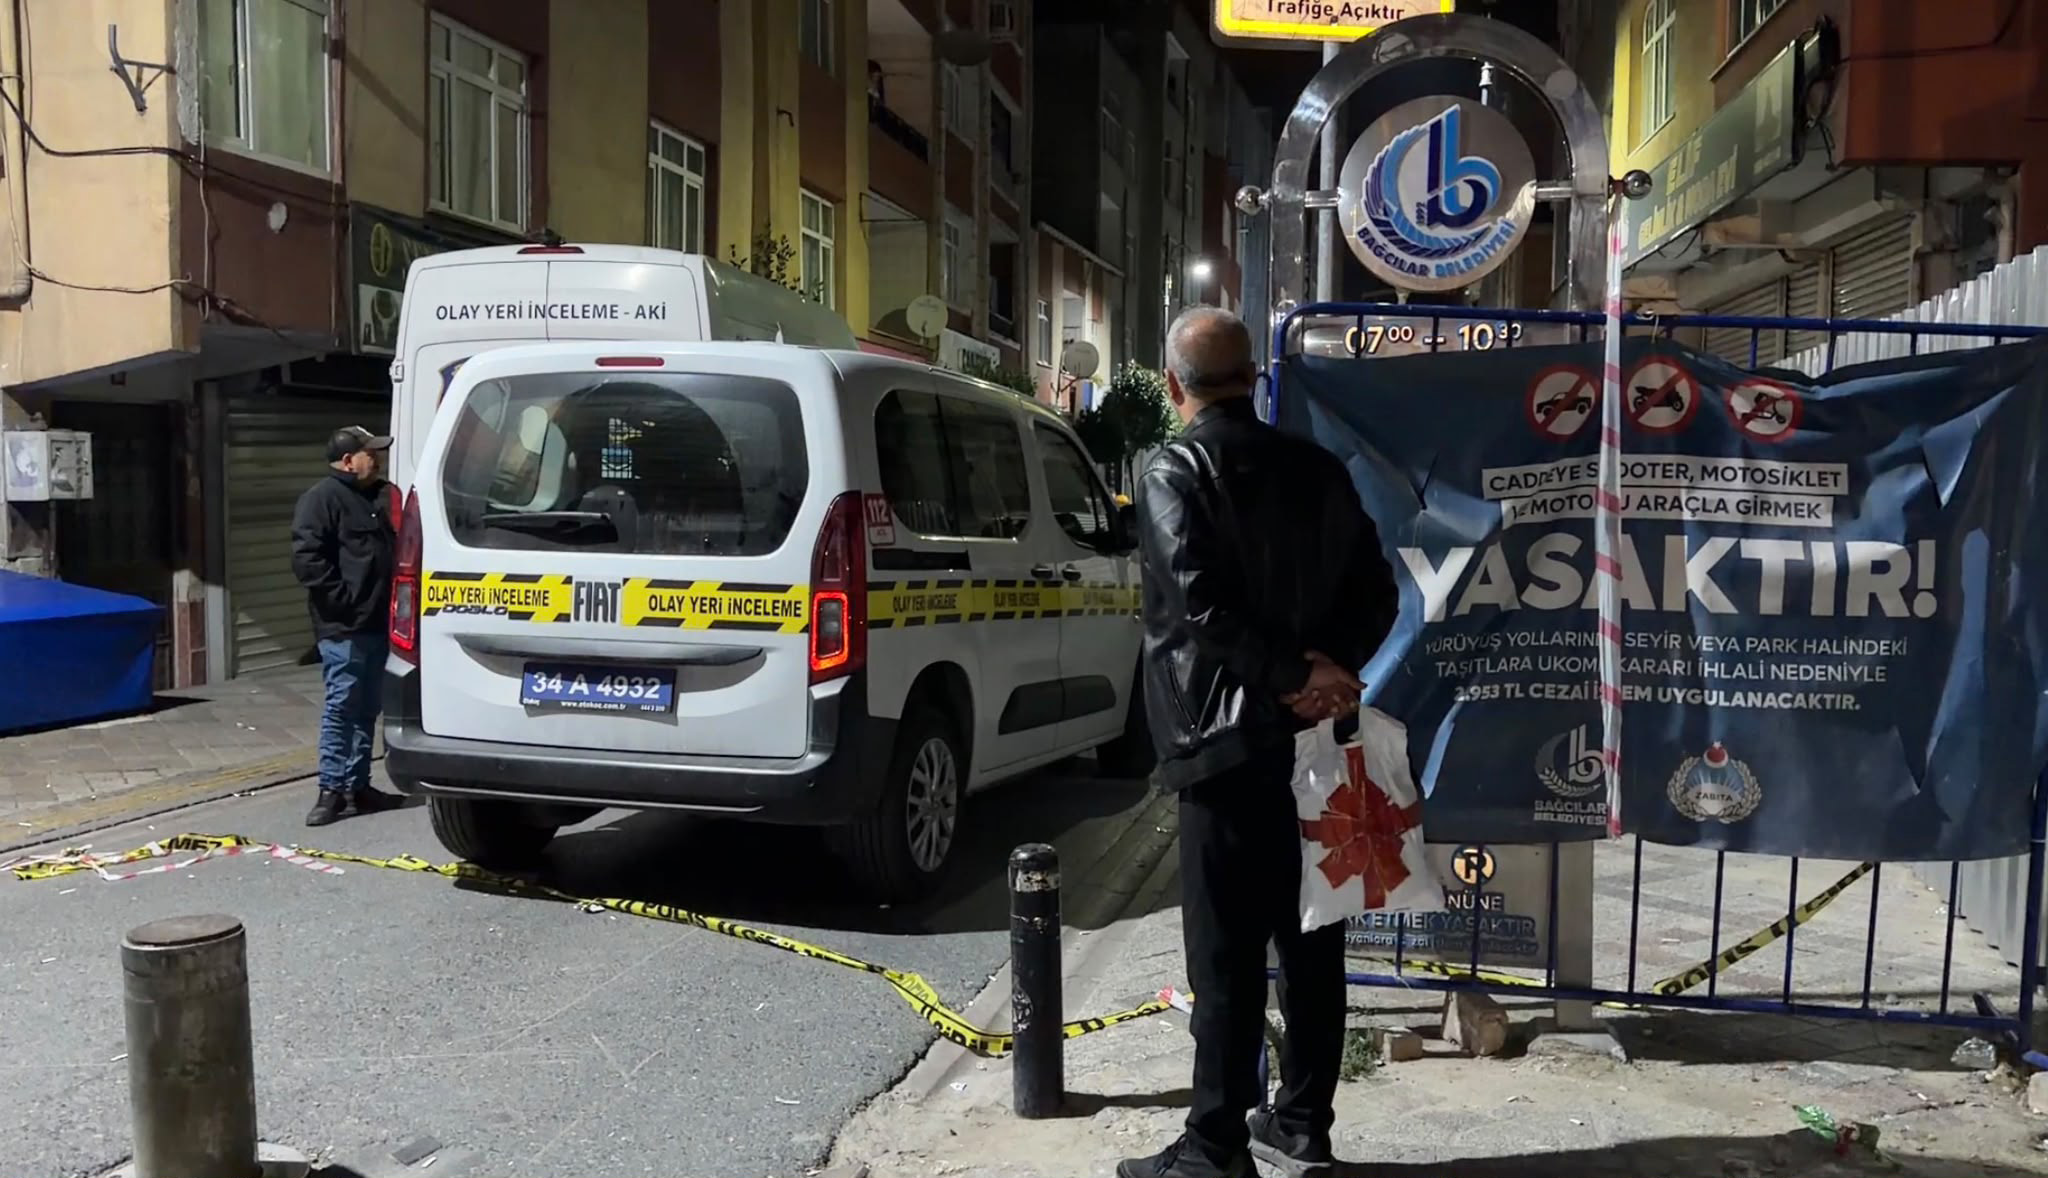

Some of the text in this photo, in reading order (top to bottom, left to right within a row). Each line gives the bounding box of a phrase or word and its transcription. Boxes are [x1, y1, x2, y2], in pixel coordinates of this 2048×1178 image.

[1267, 0, 1405, 20] Trafiğe Açıktır
[1357, 227, 1430, 277] BAĞCILAR
[436, 304, 480, 320] OLAY
[484, 301, 523, 319] YERİ
[528, 301, 619, 319] İNCELEME
[634, 302, 666, 320] AKİ
[1587, 463, 1694, 483] SOOTER,
[1700, 464, 1842, 488] MOTOSİKLET
[867, 498, 889, 523] 112
[1636, 496, 1730, 516] ARAÇLA
[1735, 495, 1822, 519] GİRMEK
[1397, 532, 1937, 623] YASAKTIR!
[427, 585, 457, 603] OLAY
[574, 580, 622, 624] FIAT
[648, 594, 686, 614] OLAY
[1426, 630, 1908, 656] YÜRÜYÜŞ YOLLARIN SEYİR VEYA PARK HALİNDEKİ
[1435, 655, 1886, 682] TAŞITLARA UKOM KARARI İHLALİ NEDENİYLE
[531, 671, 661, 699] 34 A 4932
[1504, 684, 1524, 698] TL
[1529, 681, 1589, 699] CEZAİ
[1657, 687, 1861, 710] UYGULANACAKTIR.
[1534, 798, 1607, 814] BAĞCILAR
[1695, 792, 1733, 802] ZABITA
[1446, 890, 1503, 911] NÜNE
[1441, 915, 1535, 937] YASAKTIR
